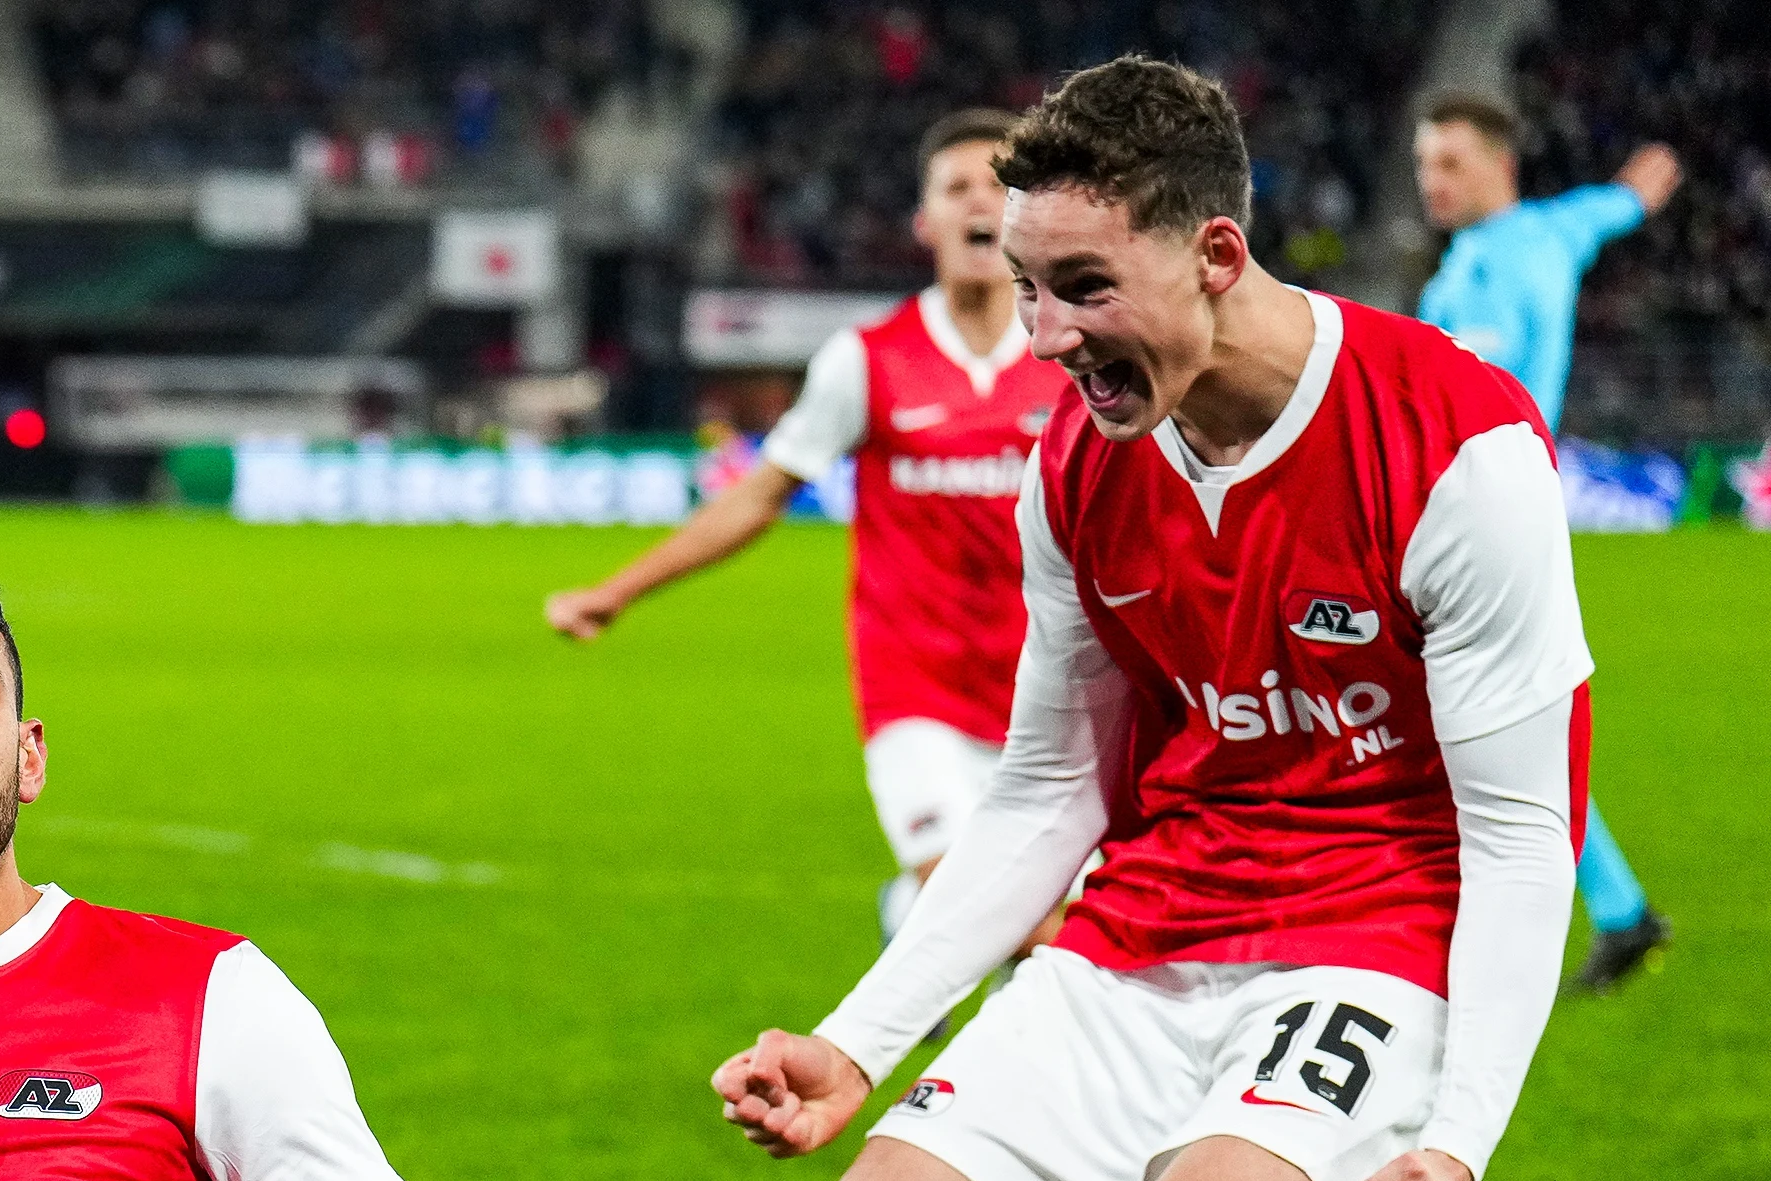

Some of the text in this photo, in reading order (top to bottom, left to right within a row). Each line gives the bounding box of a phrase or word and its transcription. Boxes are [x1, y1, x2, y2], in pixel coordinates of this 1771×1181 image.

[1301, 598, 1365, 639] AZ
[1174, 669, 1391, 741] SiNO
[1254, 1000, 1399, 1120] 15
[5, 1077, 84, 1114] AZ
